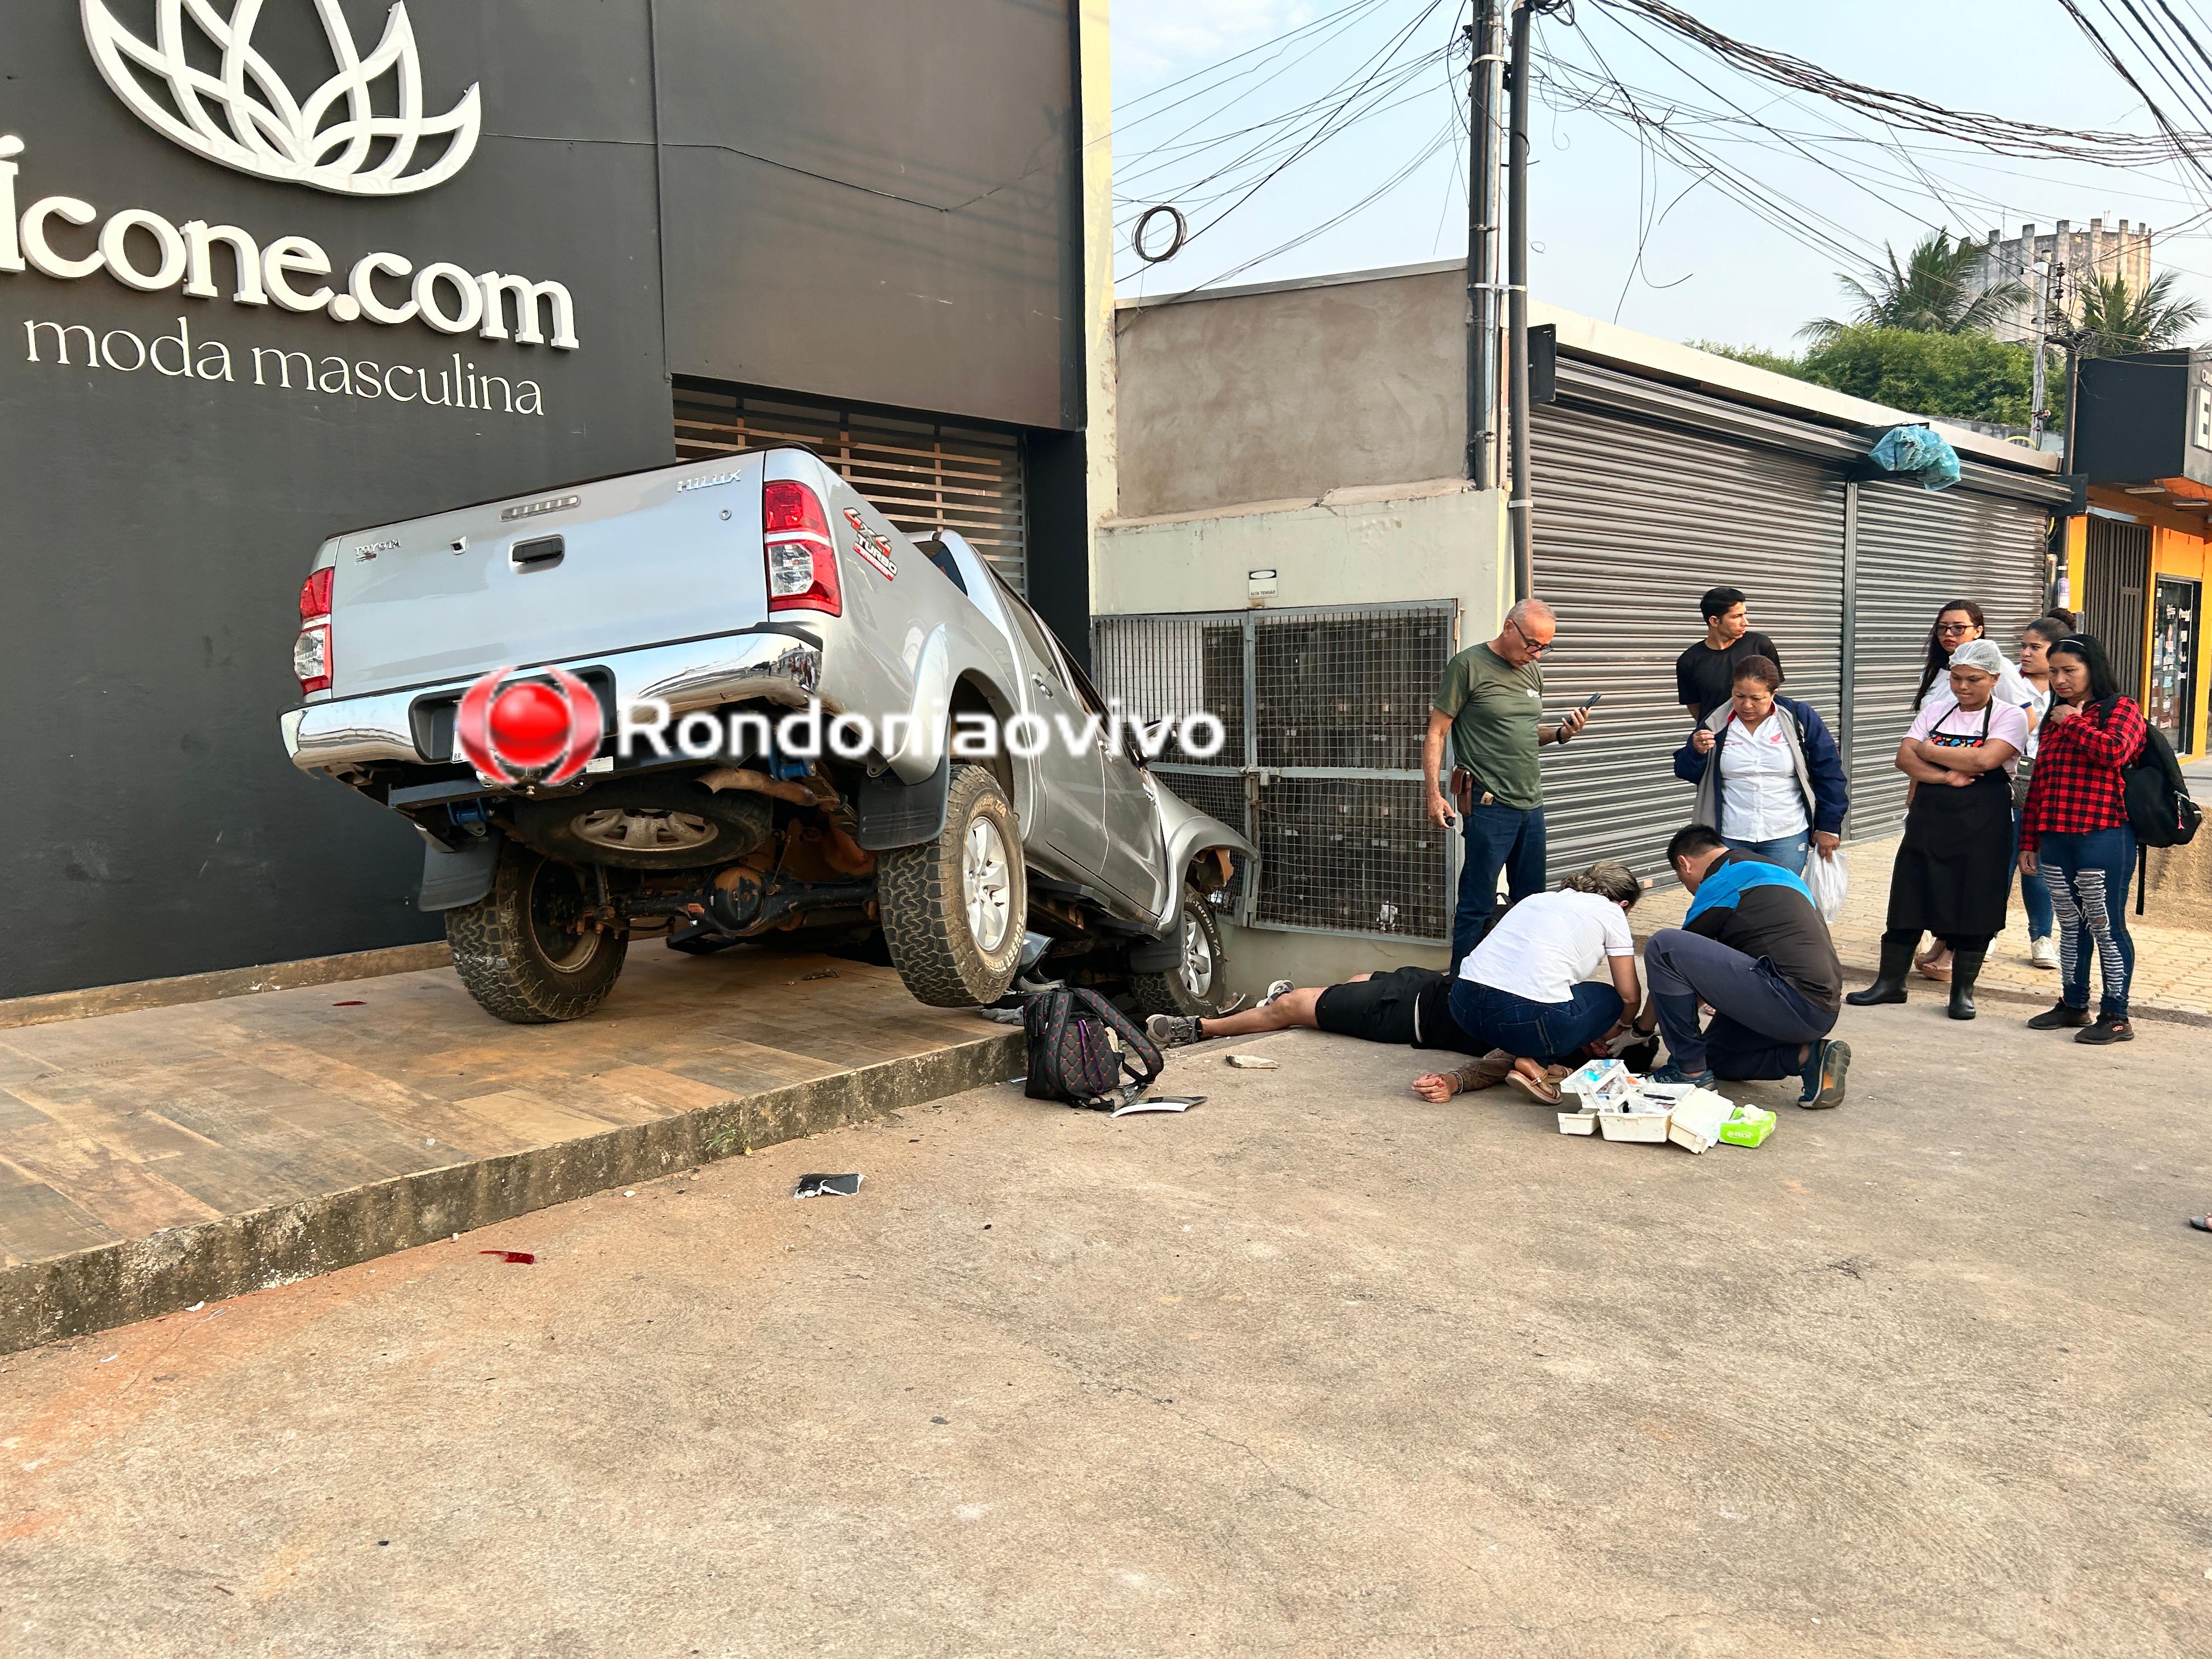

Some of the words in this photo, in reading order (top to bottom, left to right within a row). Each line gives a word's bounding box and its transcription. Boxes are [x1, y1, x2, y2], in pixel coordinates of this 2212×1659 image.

[24, 316, 234, 382] moda
[252, 347, 544, 416] masculina
[676, 469, 741, 492] HILUX
[354, 539, 400, 556] TOYOTA
[857, 533, 898, 575] TURBO
